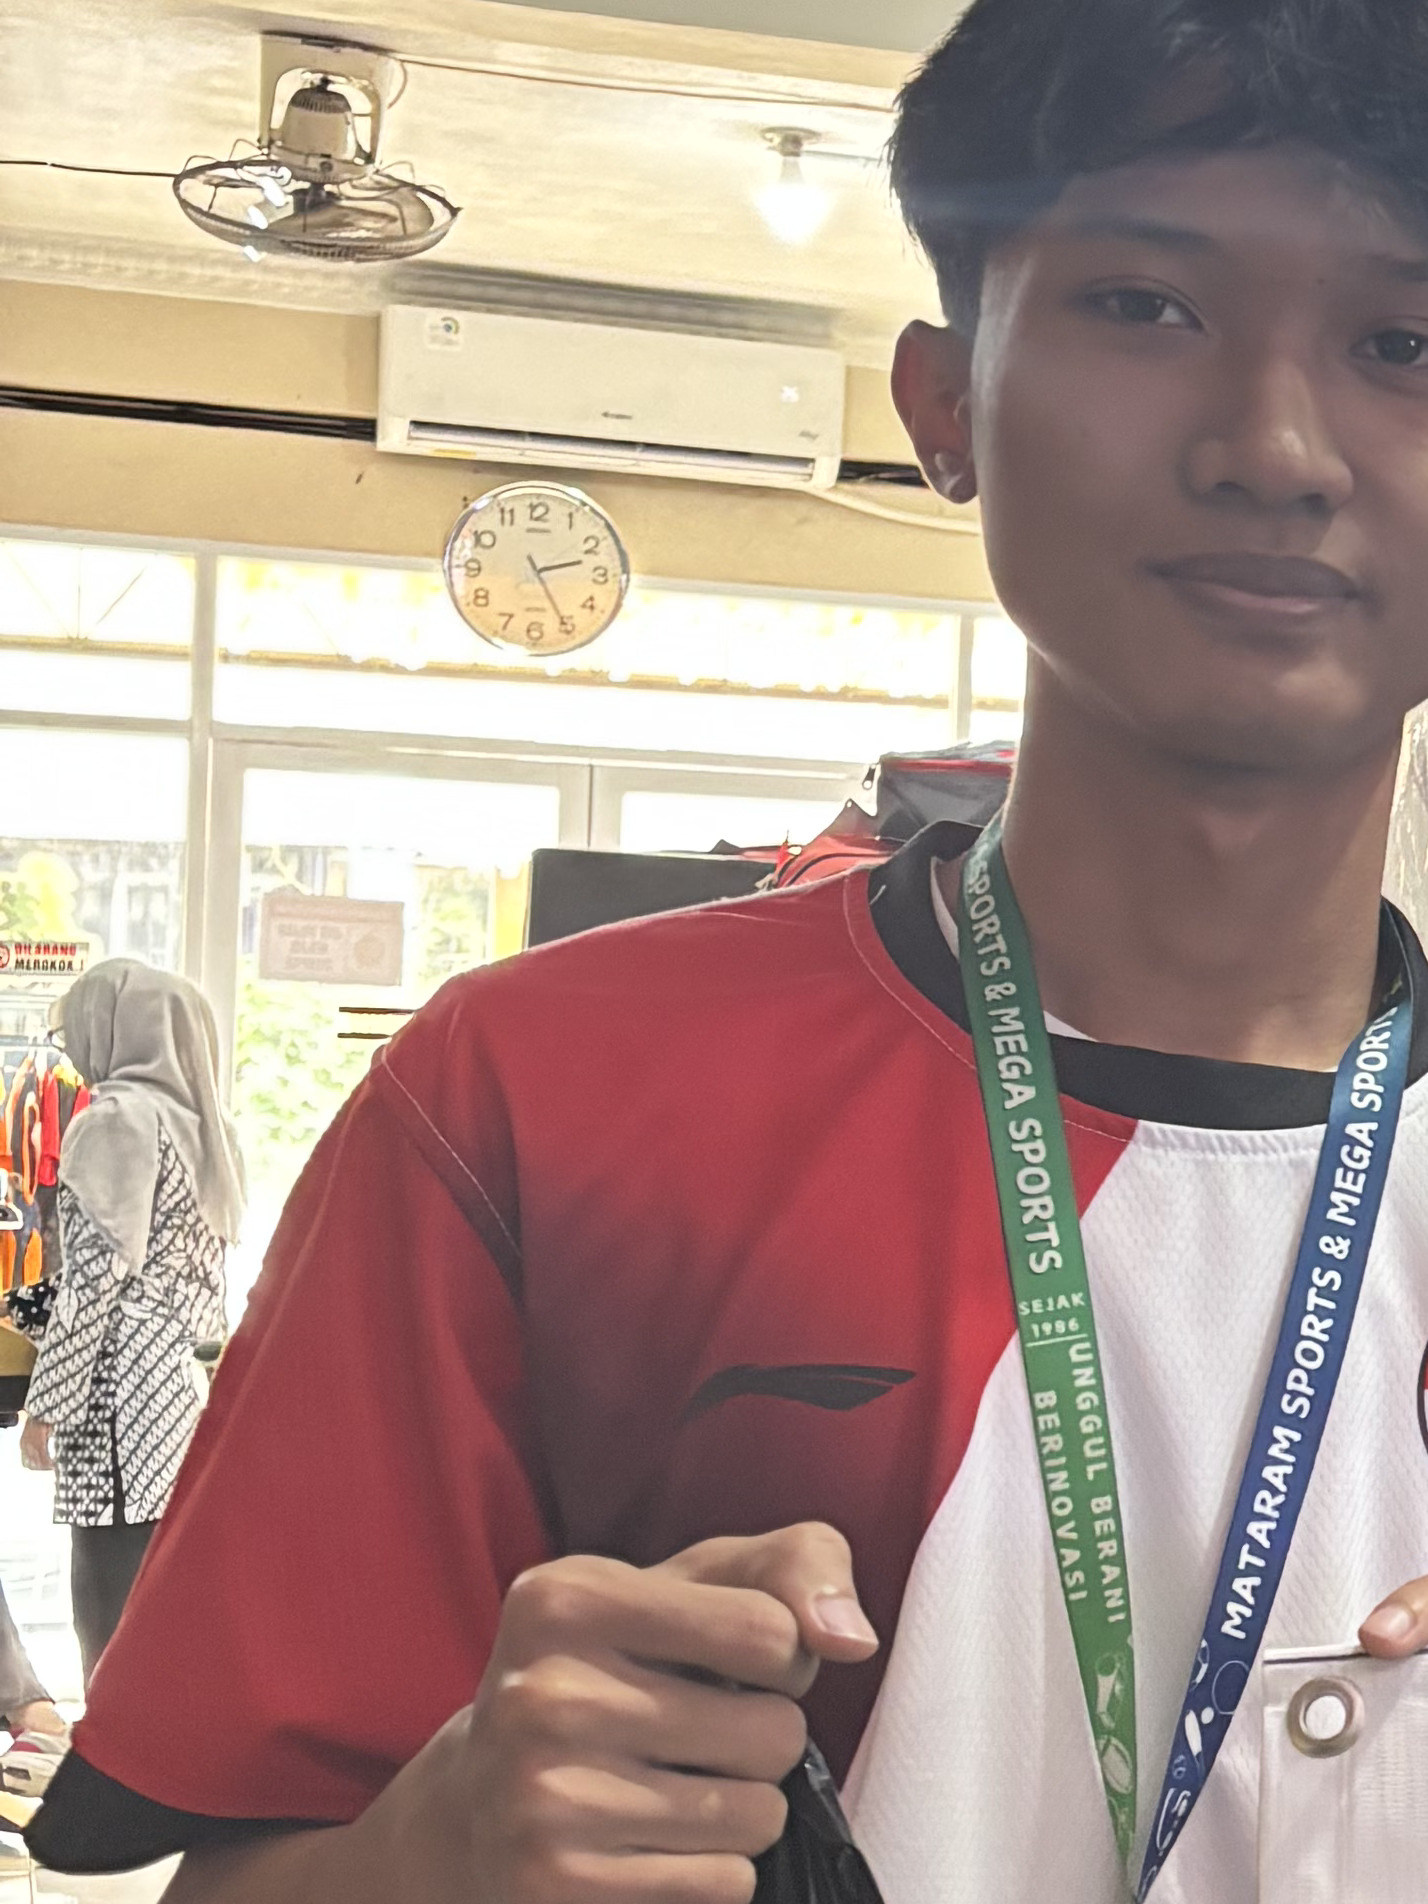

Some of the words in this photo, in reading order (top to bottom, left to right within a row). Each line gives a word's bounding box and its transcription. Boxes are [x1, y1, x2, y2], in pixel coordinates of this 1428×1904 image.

[500, 507, 516, 527] 11
[529, 501, 550, 523] 12
[567, 511, 574, 531] 1
[473, 529, 497, 550] 10
[583, 535, 600, 556] 2
[464, 558, 482, 578] 9
[591, 565, 609, 586] 3
[472, 587, 490, 608] 8
[580, 595, 597, 613] 4
[497, 612, 515, 631] 7
[525, 621, 545, 642] 6
[987, 1006, 1037, 1111] MEGA
[1326, 1127, 1381, 1227] MEGA
[1008, 1116, 1064, 1276] SPORTS
[1319, 1232, 1352, 1259] &
[1018, 1291, 1087, 1317] SEJAK
[1030, 1319, 1081, 1339] 1986
[1277, 1261, 1343, 1421] SPORTS
[1067, 1341, 1109, 1482] UNGGUL
[1090, 1494, 1126, 1625] BERANI
[1033, 1389, 1089, 1603] BERINOVASI
[1221, 1429, 1303, 1640] MATARAM
